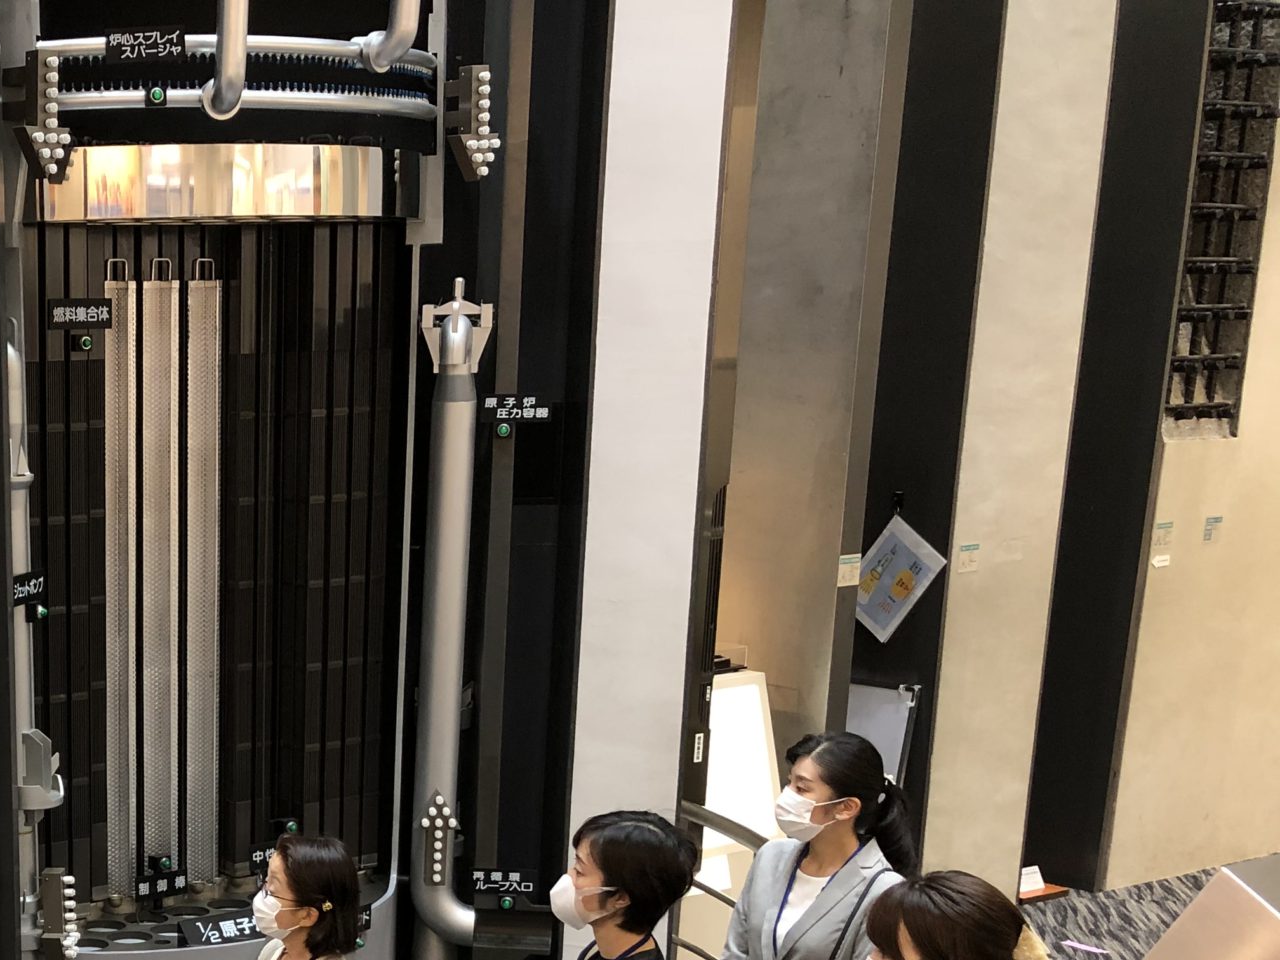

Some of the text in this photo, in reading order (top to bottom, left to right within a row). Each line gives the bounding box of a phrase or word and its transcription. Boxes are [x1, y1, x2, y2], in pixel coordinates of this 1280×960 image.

[109, 30, 180, 46] 炉心スプレイ
[121, 43, 182, 59] スパージャ
[53, 305, 110, 323] 燃料集合体
[496, 407, 549, 418] 圧力容器
[475, 881, 533, 892] ループ入口
